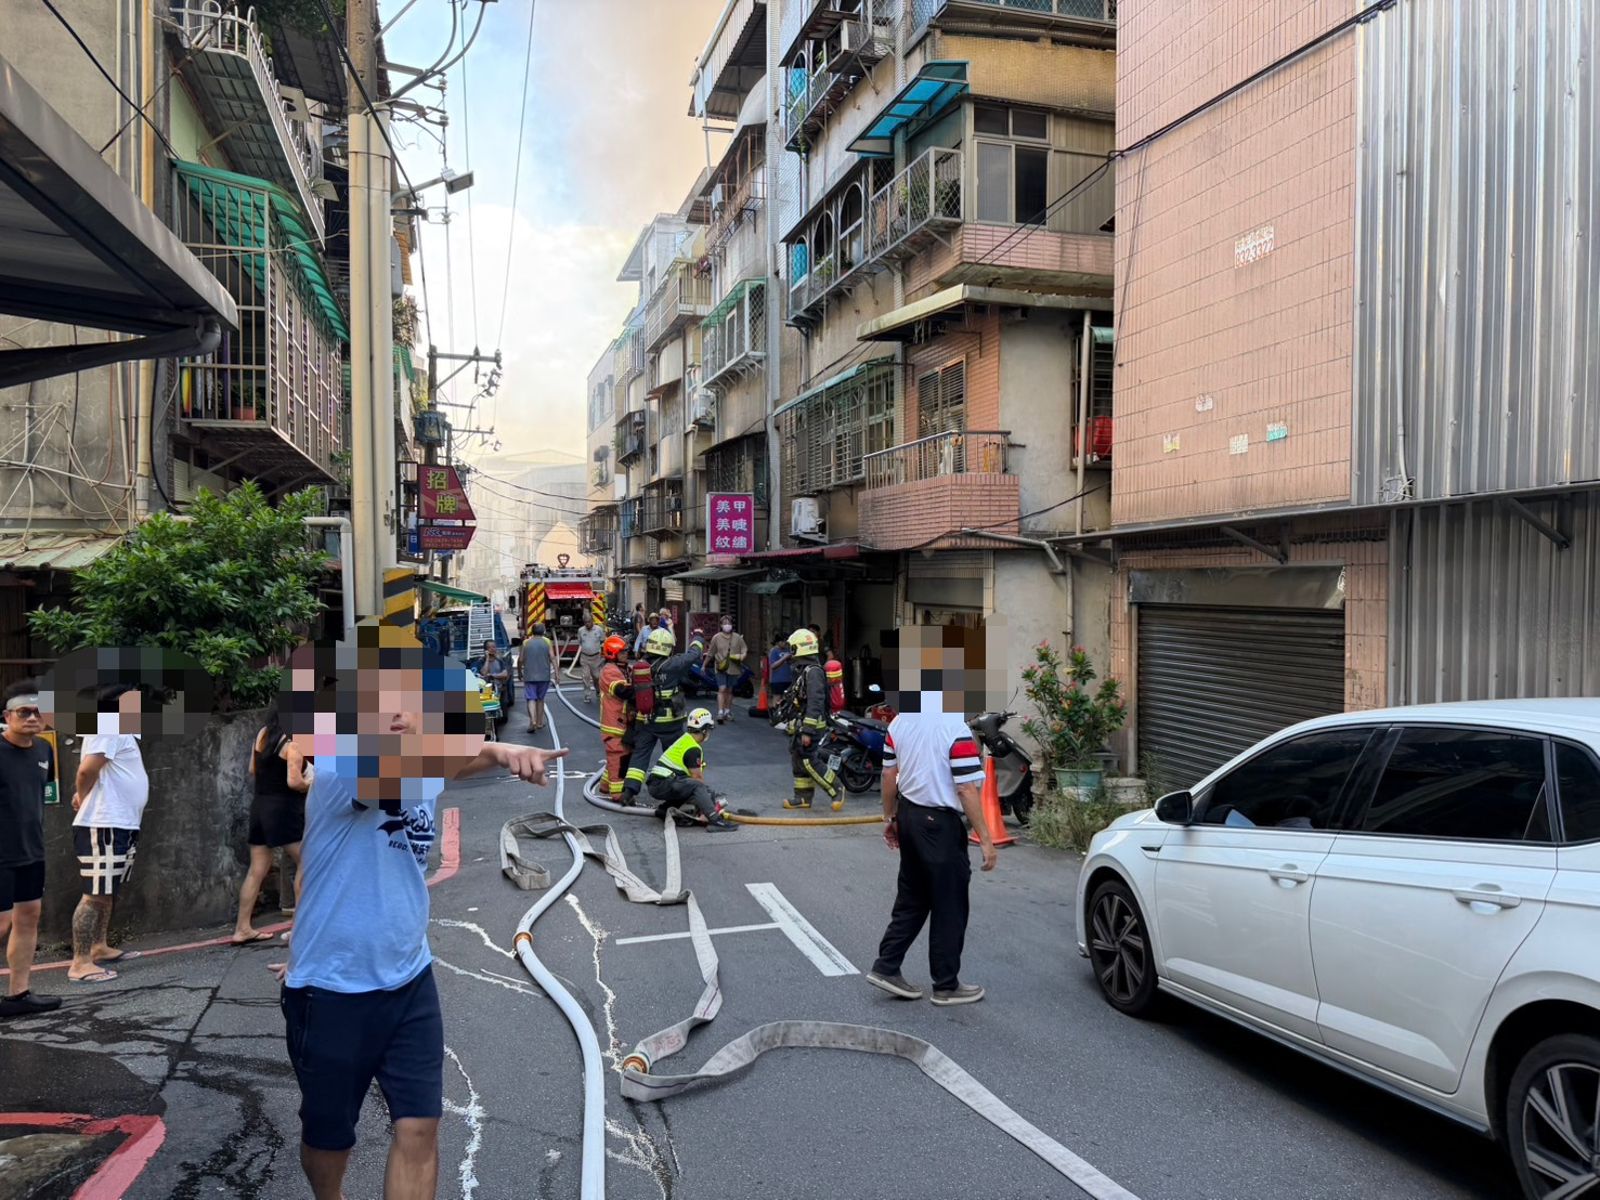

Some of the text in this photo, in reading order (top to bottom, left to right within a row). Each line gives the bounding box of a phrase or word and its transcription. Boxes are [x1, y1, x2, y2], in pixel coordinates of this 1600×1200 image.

[427, 470, 457, 514] 招牌
[716, 500, 746, 513] 美甲
[716, 518, 747, 531] 美睫
[716, 536, 747, 549] 紋繡
